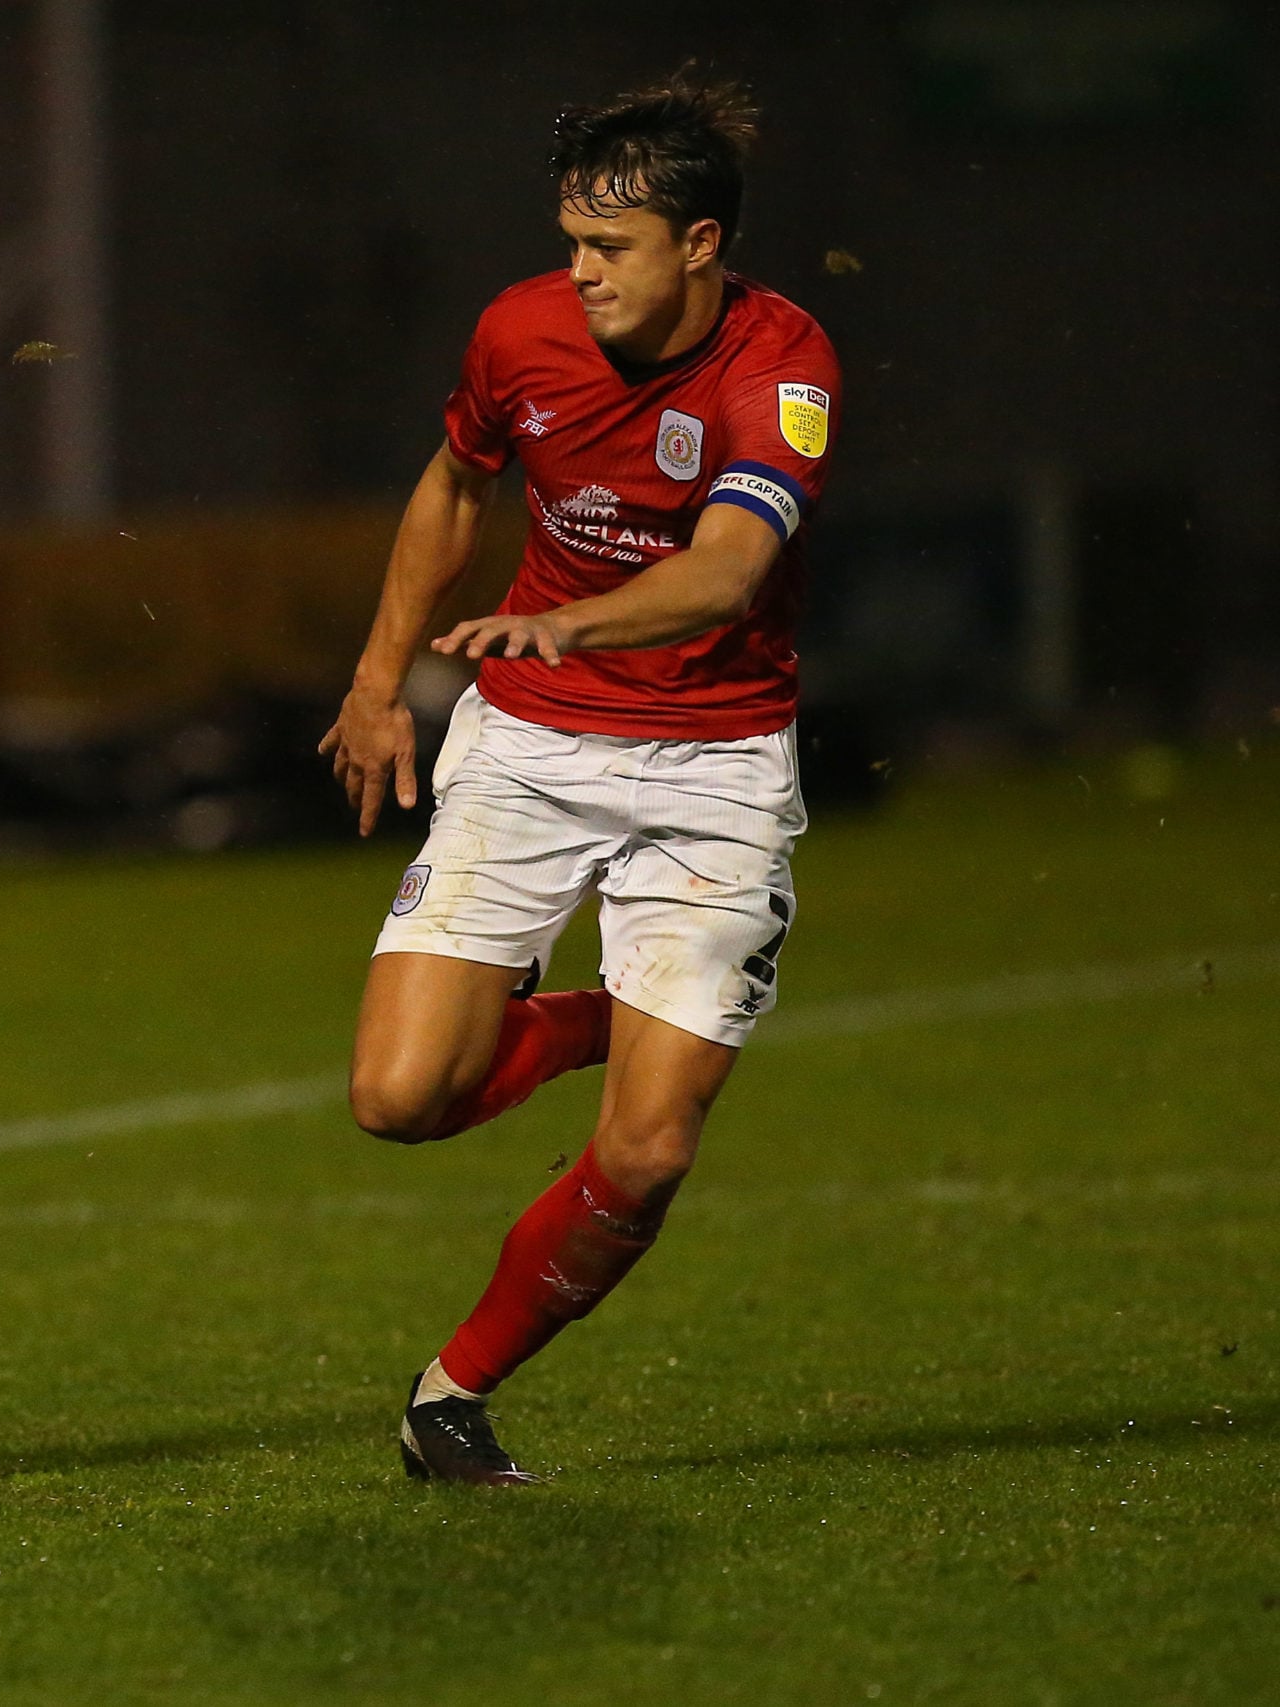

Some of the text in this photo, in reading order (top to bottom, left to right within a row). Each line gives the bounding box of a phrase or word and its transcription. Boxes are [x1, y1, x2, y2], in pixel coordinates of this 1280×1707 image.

[784, 387, 825, 406] sky bet
[795, 404, 812, 413] STAY
[519, 419, 549, 437] FBT
[792, 423, 820, 438] DEPOSIT
[798, 419, 811, 428] SET
[798, 433, 816, 444] LIMIT
[723, 476, 793, 517] EFL CAPTAIN
